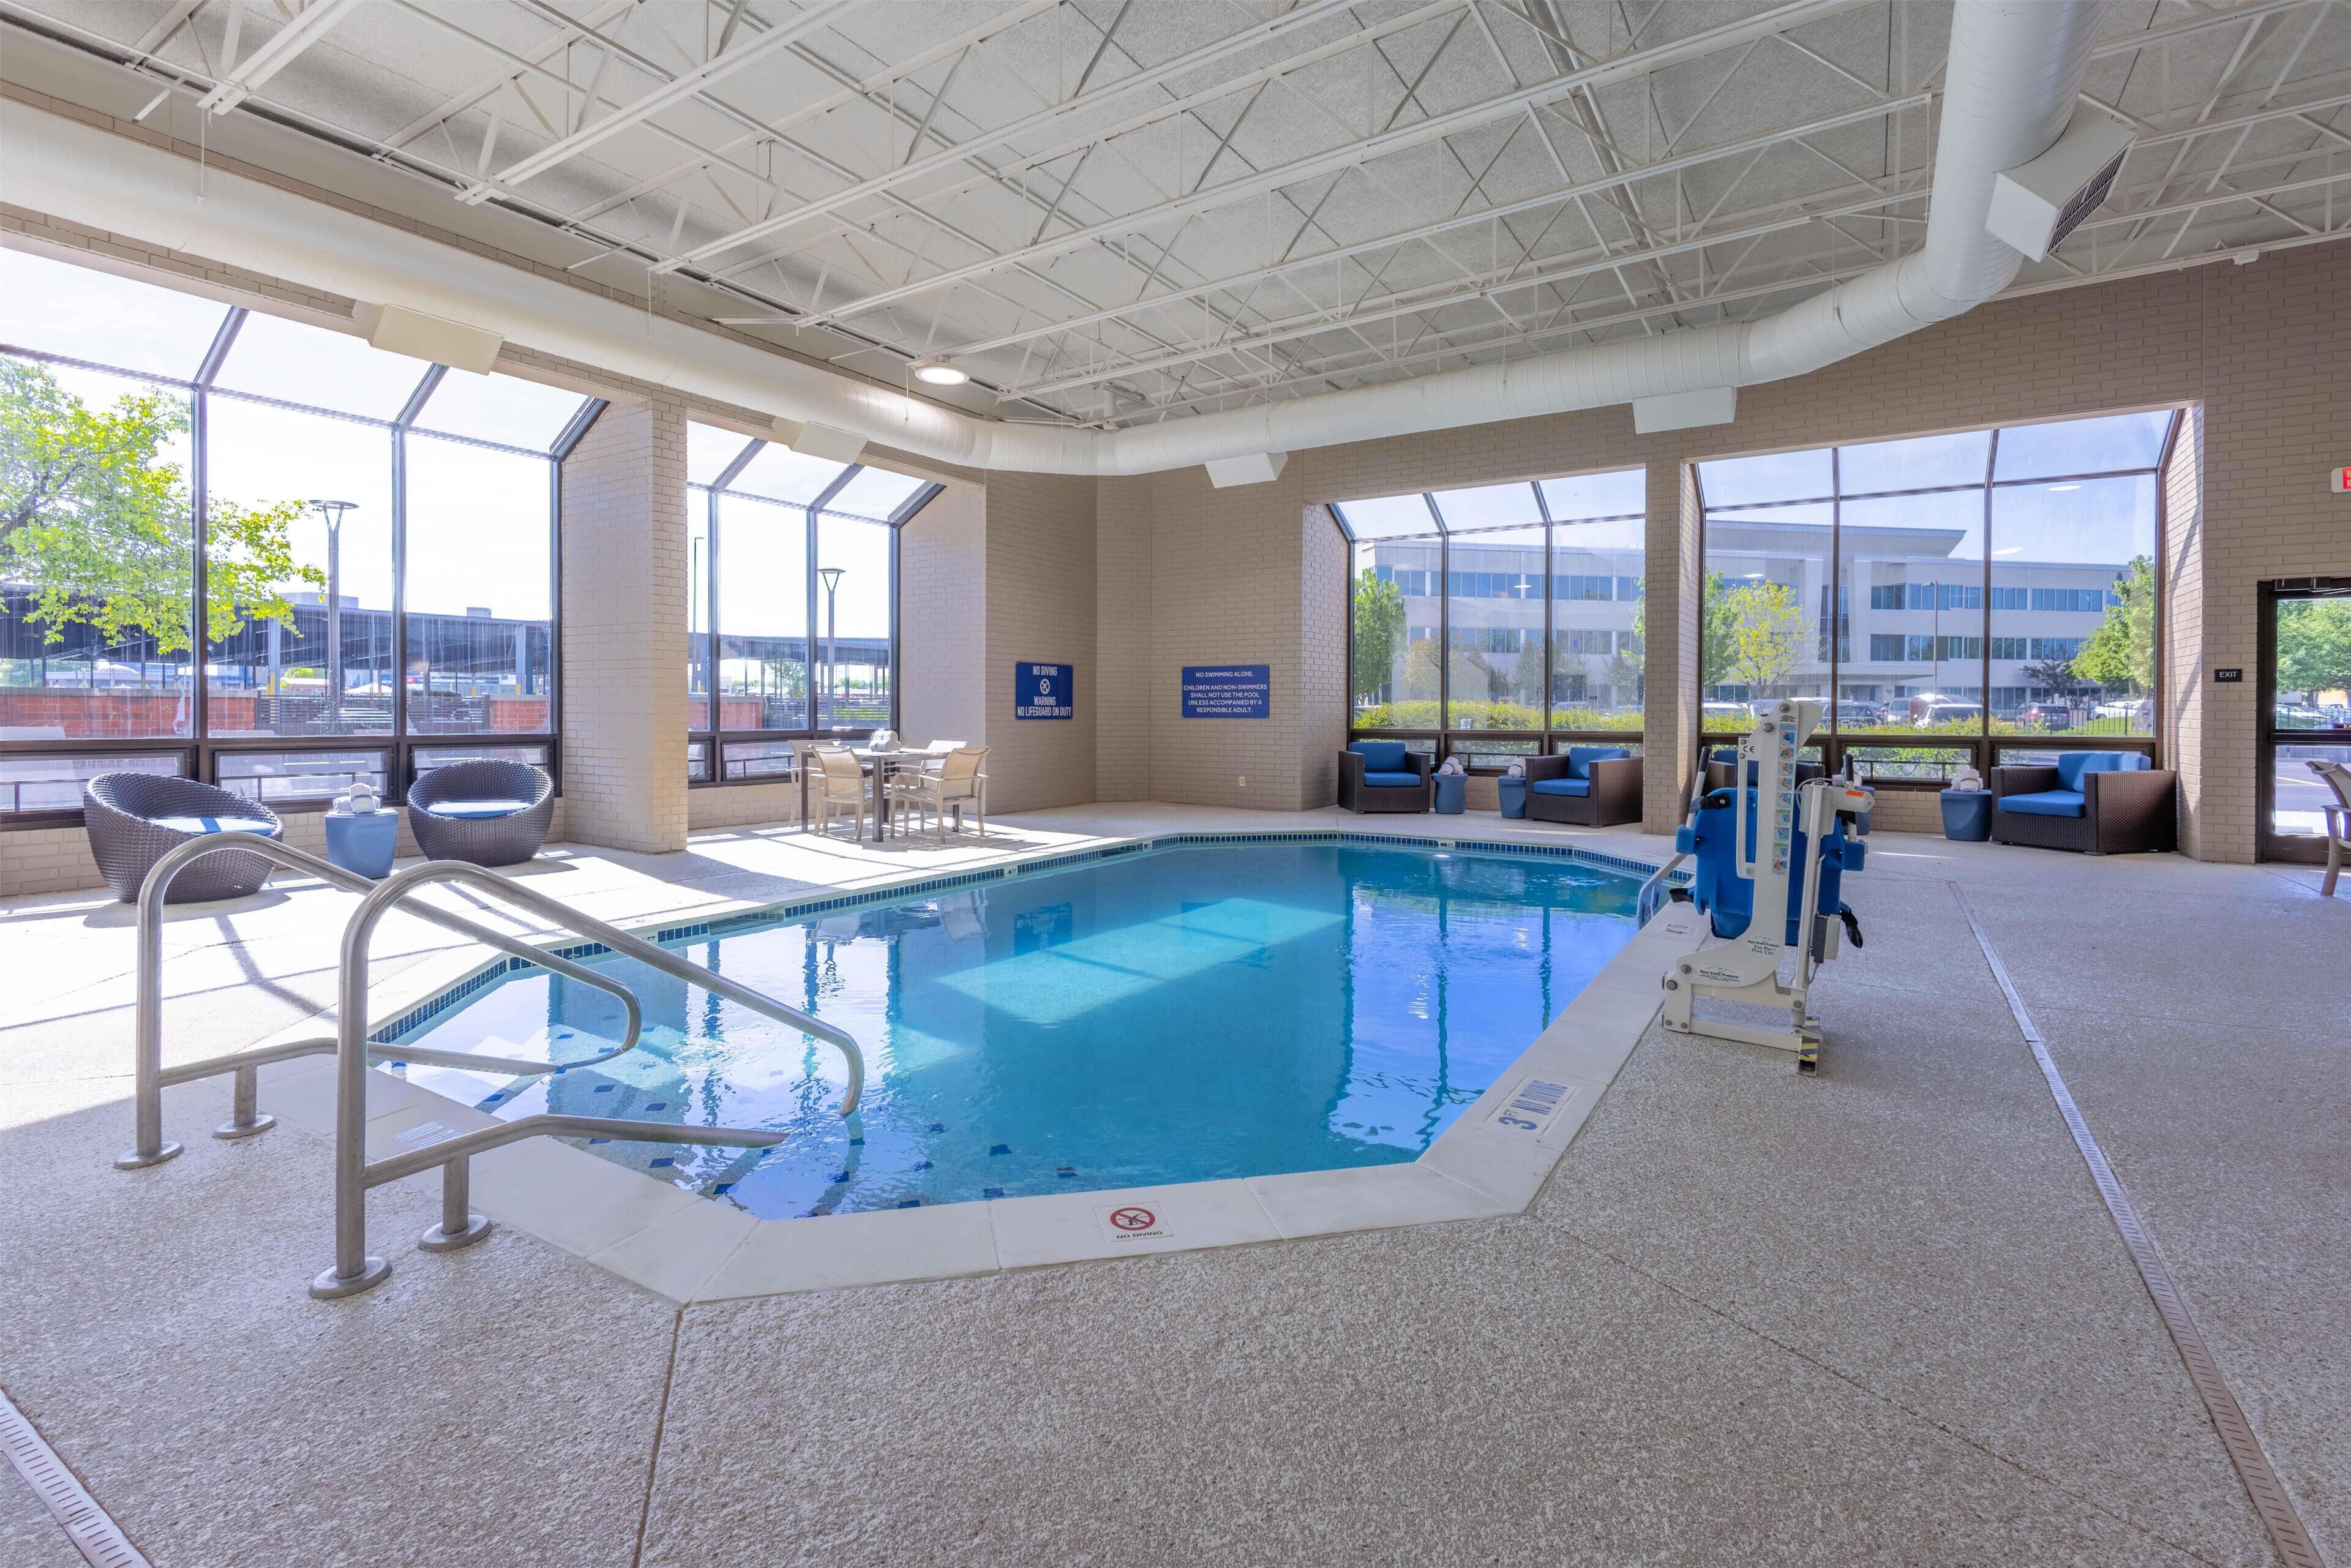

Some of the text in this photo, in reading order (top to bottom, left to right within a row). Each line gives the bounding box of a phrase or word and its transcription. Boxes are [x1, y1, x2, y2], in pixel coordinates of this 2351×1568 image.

[1033, 666, 1057, 676] NO DIVING
[1034, 696, 1056, 706] WARNING
[1018, 707, 1072, 716] NO LIFEGUARD ON DUTY
[1510, 1080, 1568, 1115] NO DIVING
[1498, 1116, 1537, 1130] 3
